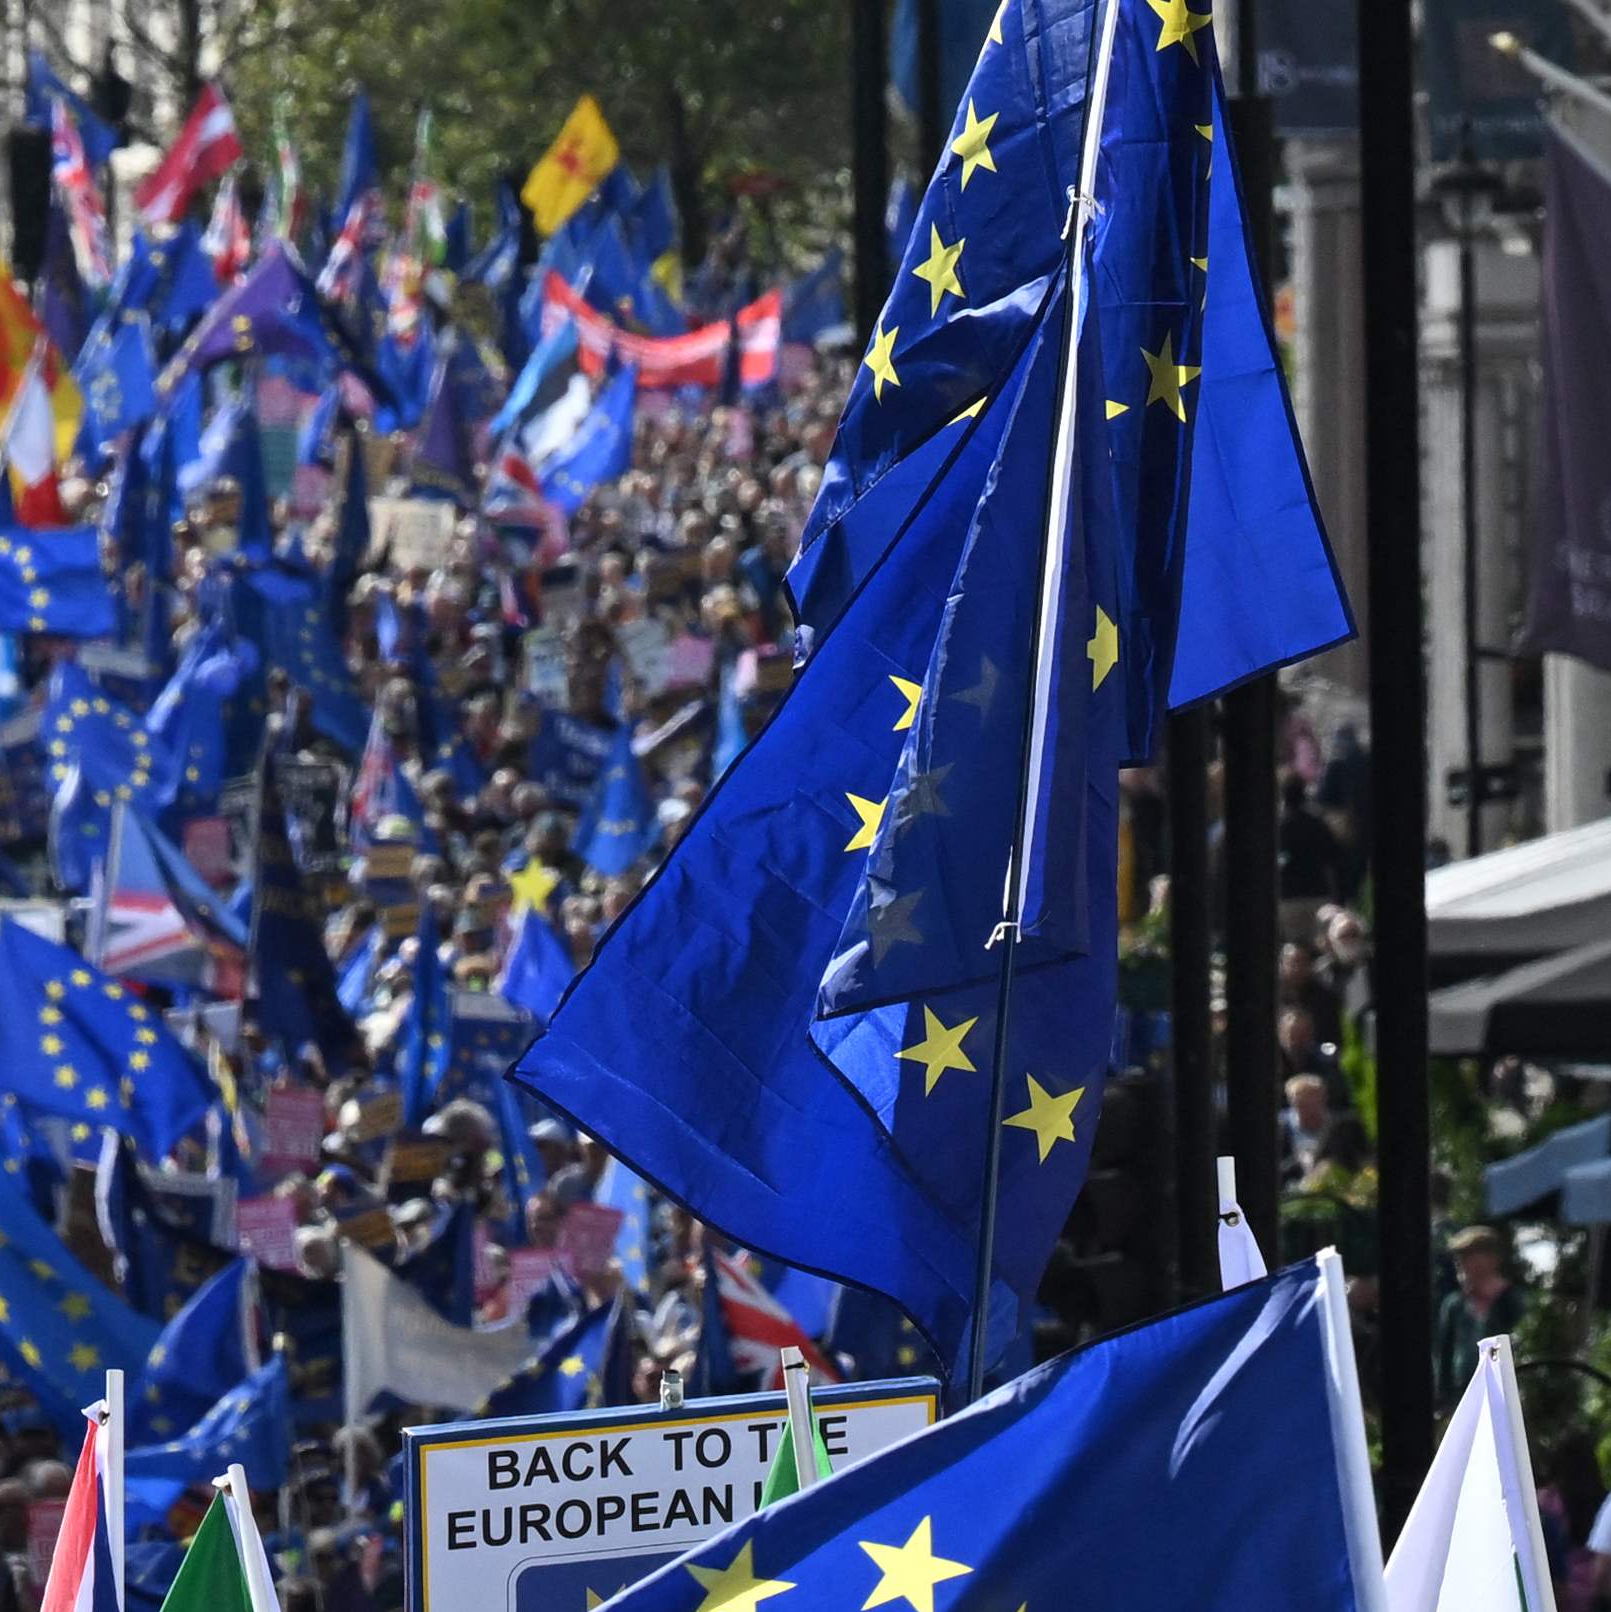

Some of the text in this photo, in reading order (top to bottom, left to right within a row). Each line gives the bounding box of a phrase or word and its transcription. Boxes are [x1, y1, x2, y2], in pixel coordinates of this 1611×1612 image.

[488, 1416, 849, 1490] BACK TO TE
[447, 1483, 734, 1551] EUROPEAN
